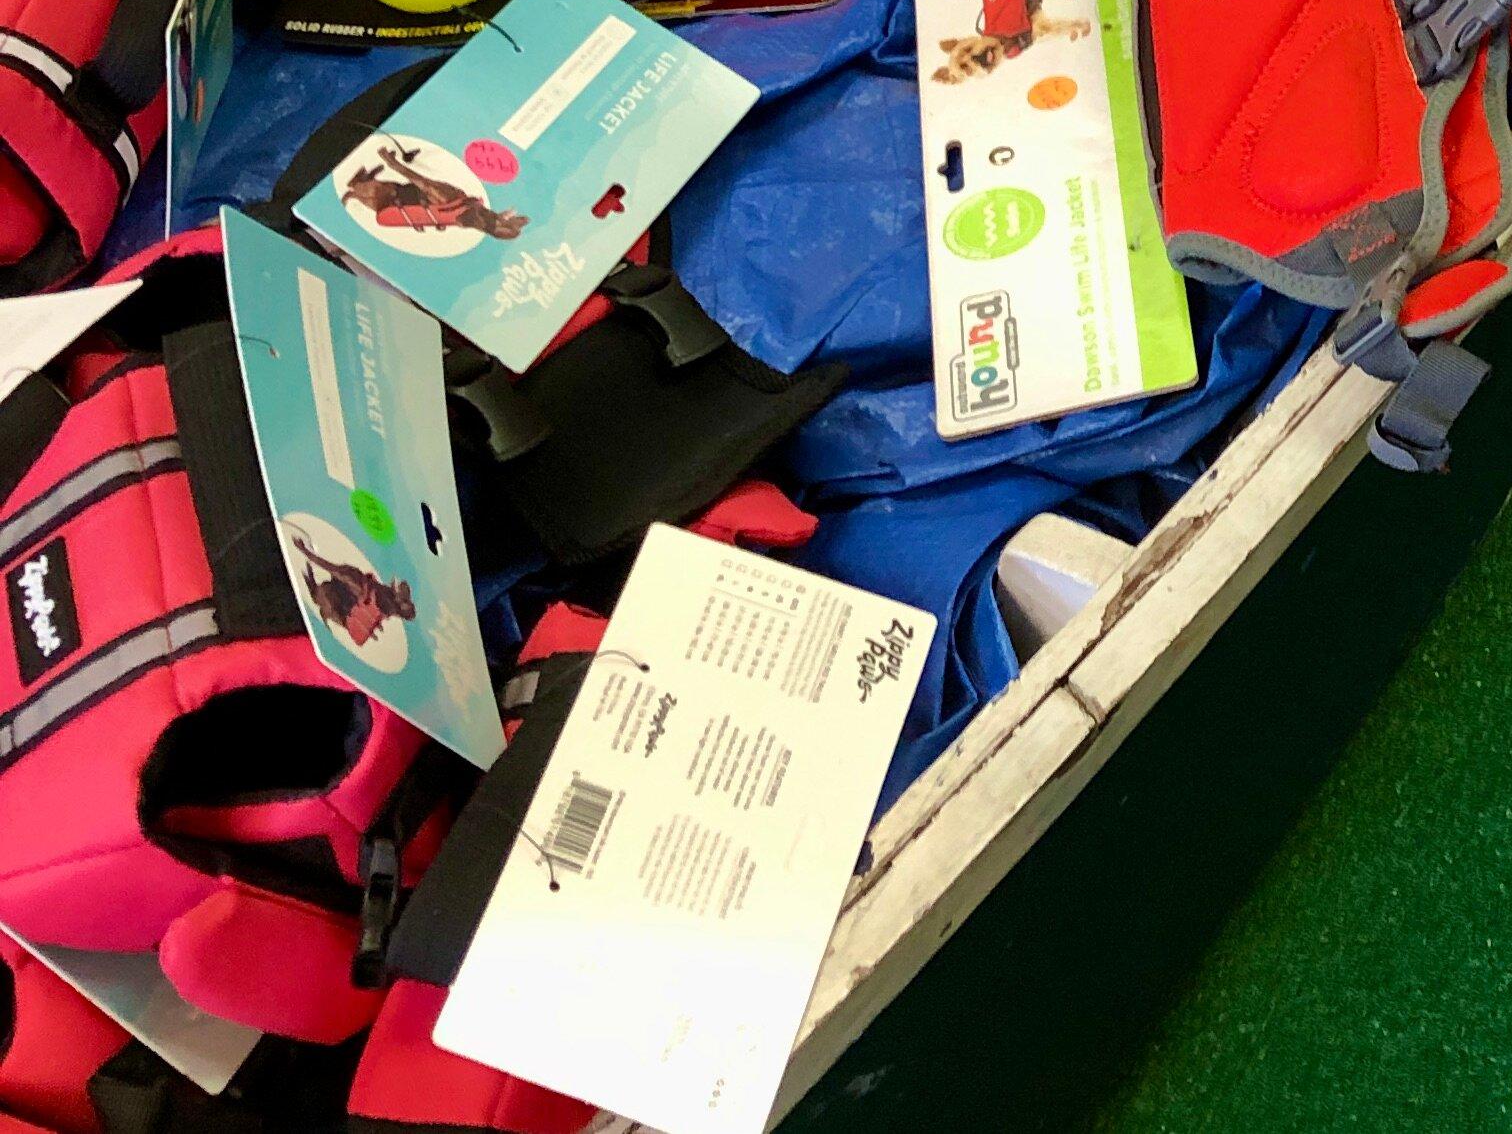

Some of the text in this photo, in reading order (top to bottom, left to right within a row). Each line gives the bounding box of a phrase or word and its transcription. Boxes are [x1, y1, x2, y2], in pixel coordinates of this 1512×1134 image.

[284, 20, 320, 32] SOLID
[322, 23, 364, 36] RUBBER
[644, 51, 678, 88] LIFE
[599, 79, 646, 135] JACKET
[1063, 175, 1087, 230] Jacket
[537, 243, 586, 307] Zippy
[1069, 232, 1090, 267] Life
[1073, 268, 1096, 317] Swim
[352, 301, 388, 441] LIFE JACKET
[965, 295, 1013, 408] hound
[1080, 321, 1104, 392] Dawson
[854, 636, 889, 703] Paws
[873, 618, 915, 681] Zippy
